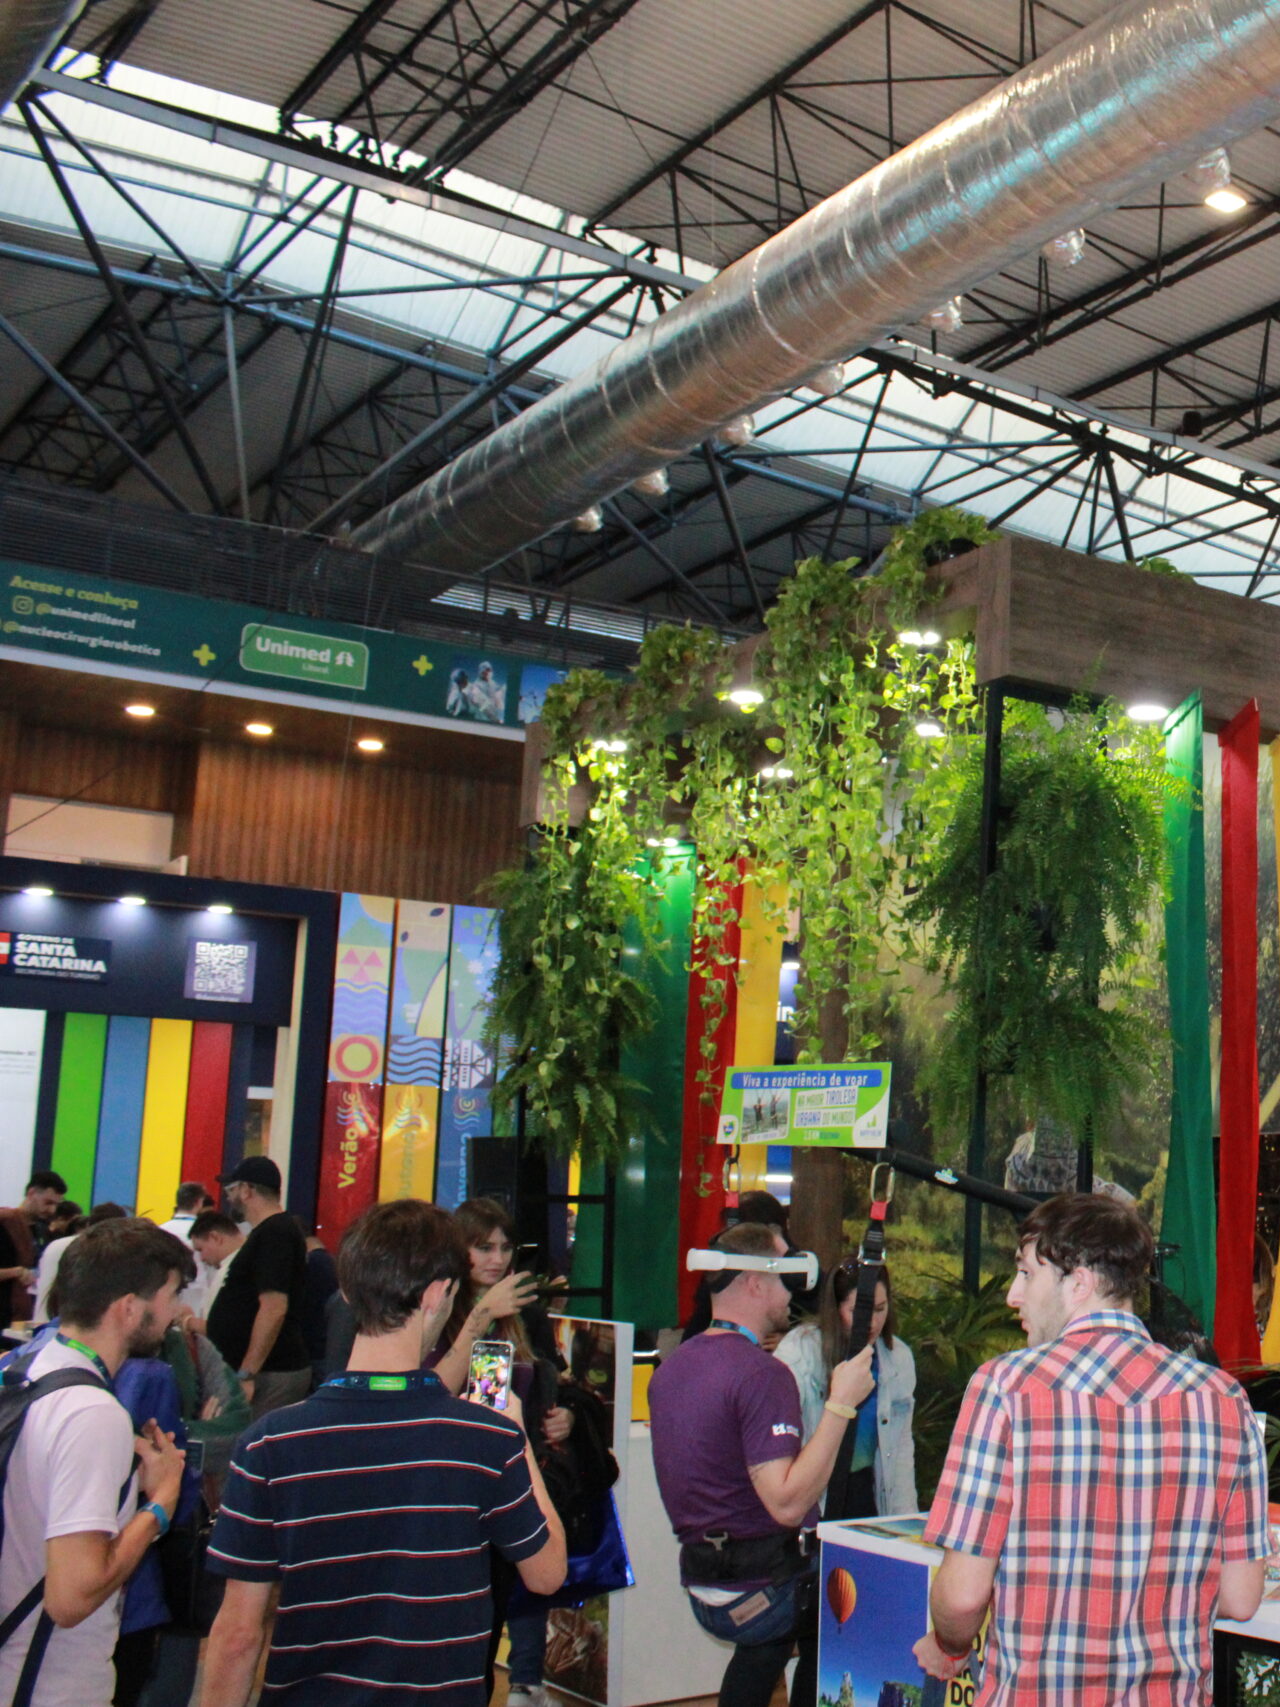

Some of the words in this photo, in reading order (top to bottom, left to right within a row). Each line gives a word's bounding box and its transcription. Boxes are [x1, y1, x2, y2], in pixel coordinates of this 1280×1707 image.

[9, 576, 63, 595] Acesse
[65, 588, 75, 597] e
[77, 592, 139, 610] conheça
[256, 637, 331, 663] Unimed
[17, 934, 61, 943] GOVERNO
[15, 941, 77, 957] SANTA
[13, 954, 107, 973] CATARINA
[743, 1074, 760, 1087] Viva
[764, 1077, 769, 1087] a
[772, 1072, 826, 1088] experiência
[829, 1072, 841, 1086] de
[845, 1075, 868, 1086] voar
[338, 1127, 358, 1189] Verão
